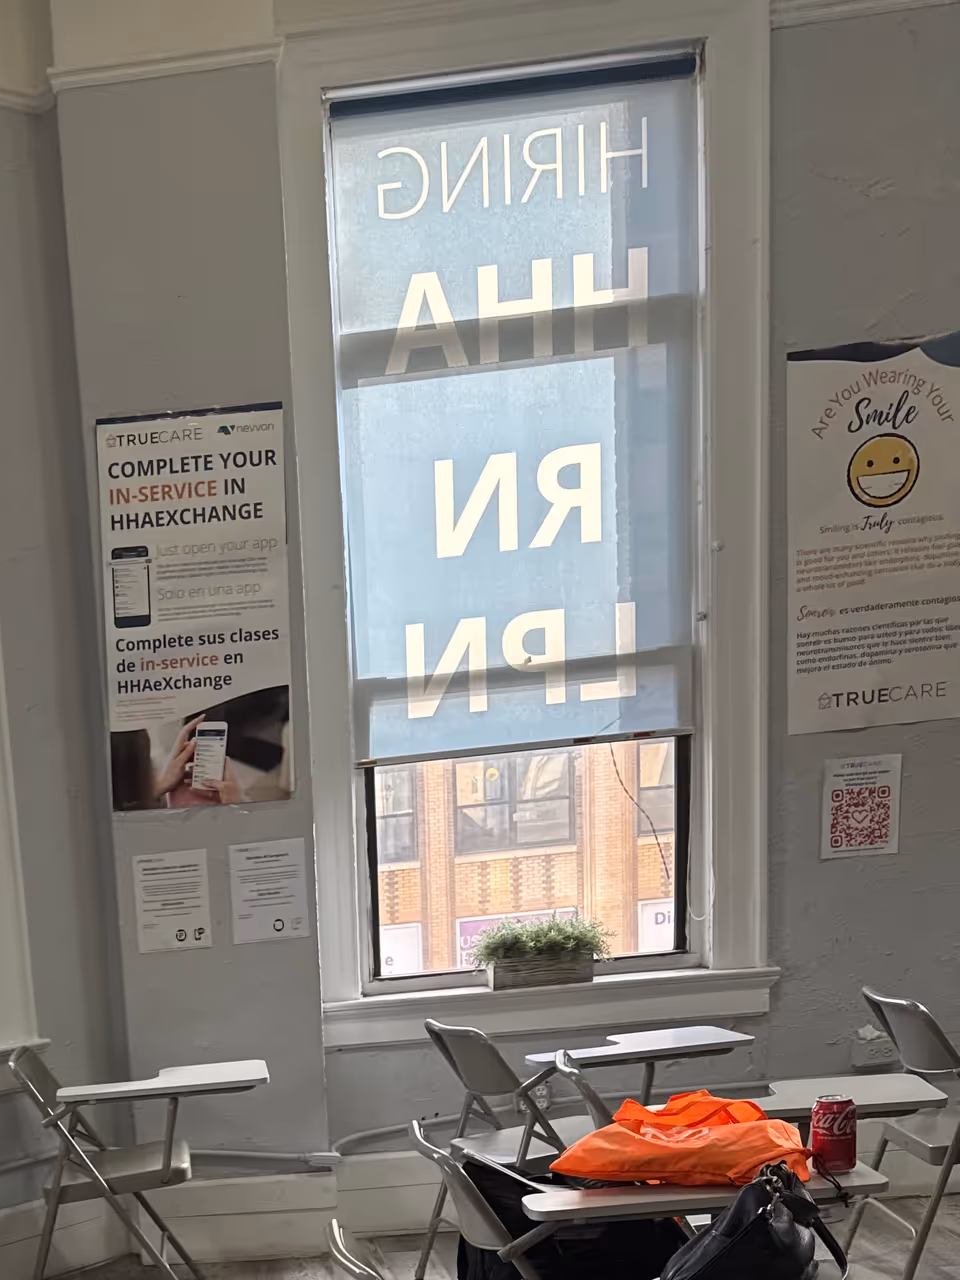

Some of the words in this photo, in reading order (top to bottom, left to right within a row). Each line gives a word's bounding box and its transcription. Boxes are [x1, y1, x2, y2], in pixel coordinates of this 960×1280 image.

[811, 407, 837, 440] Are
[828, 380, 862, 407] You
[862, 368, 927, 395] Wearing
[925, 382, 954, 423] Your
[847, 390, 920, 433] Smile
[116, 427, 204, 447] TRUECARE
[108, 454, 214, 479] COMPLETE
[219, 449, 277, 469] YOUR
[110, 480, 217, 505] IN-SERVICE
[224, 477, 245, 495] IN
[111, 502, 263, 531] HHAEXCHANGE
[819, 524, 851, 534] Smiling
[860, 511, 894, 534] Truly
[155, 544, 179, 560] Just
[183, 541, 216, 557] open
[219, 540, 249, 555] your
[252, 537, 278, 552] app
[157, 587, 185, 601] Solo
[188, 587, 205, 598] en
[209, 585, 233, 596] una
[236, 582, 261, 596] app
[850, 599, 919, 613] verdaderamente
[115, 634, 194, 653] Complete
[198, 632, 225, 646] sus
[230, 627, 279, 643] clases
[796, 632, 811, 640] Hay
[812, 629, 840, 637] muchas
[842, 625, 870, 633] razones
[116, 659, 135, 673] de
[140, 653, 219, 672] in-service
[223, 652, 244, 664] en
[117, 674, 233, 694] HHAeXchange
[831, 681, 948, 707] TRUECARE
